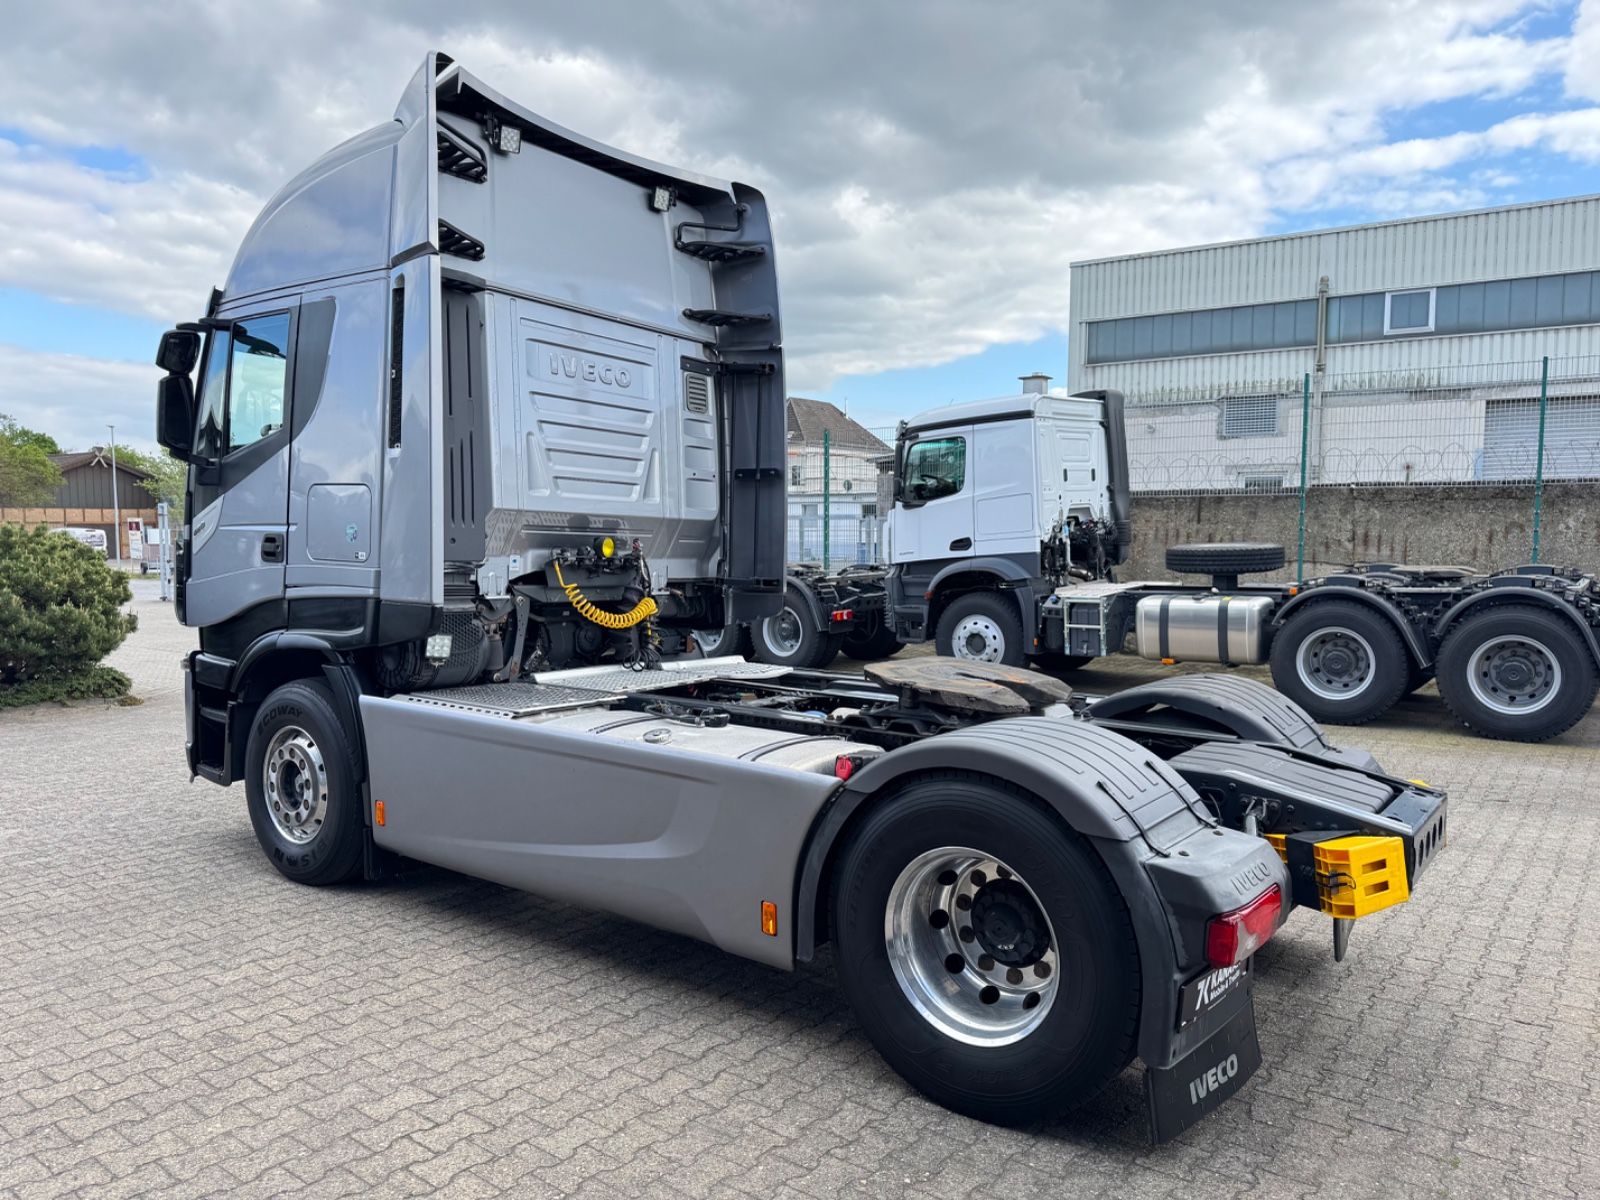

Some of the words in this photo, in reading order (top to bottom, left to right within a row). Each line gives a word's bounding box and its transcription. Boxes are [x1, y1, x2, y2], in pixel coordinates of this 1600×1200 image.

[549, 352, 632, 389] IVECO
[257, 704, 303, 736] ECOWAY
[1230, 861, 1271, 896] IVECO
[1189, 1053, 1239, 1105] IVECO
